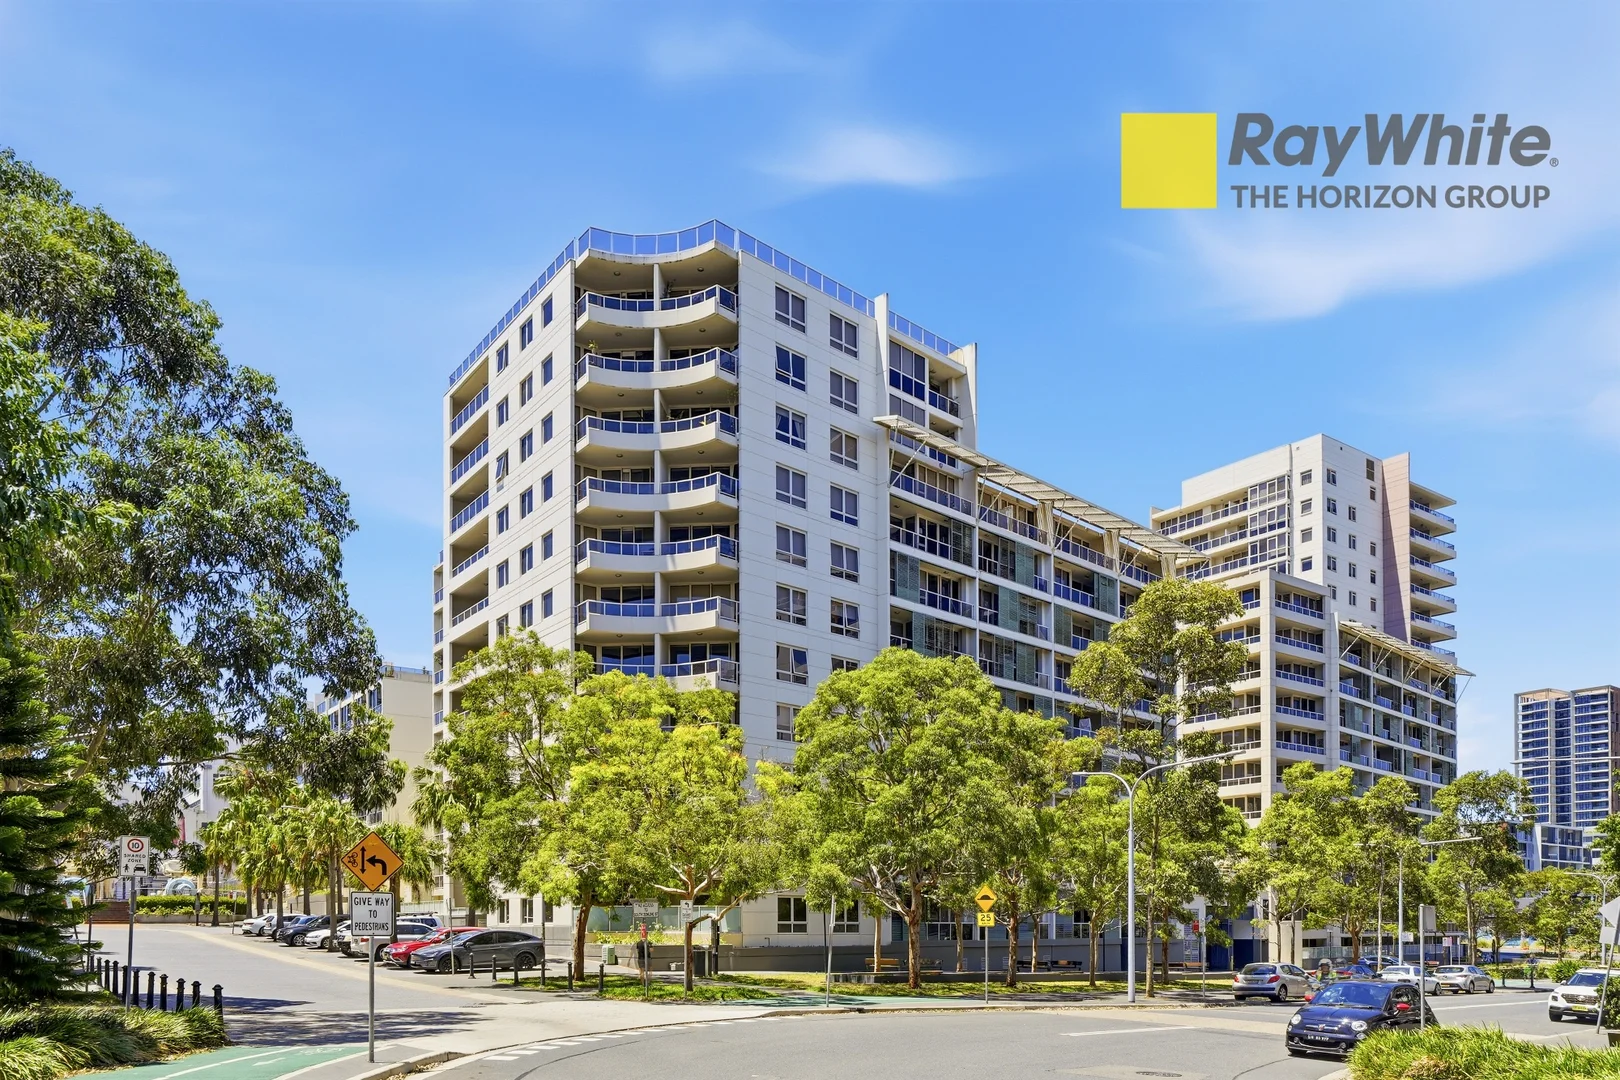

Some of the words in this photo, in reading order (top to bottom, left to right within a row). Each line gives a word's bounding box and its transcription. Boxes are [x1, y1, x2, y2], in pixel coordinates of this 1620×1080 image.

[353, 897, 372, 906] GIVE
[375, 897, 390, 907] WAY
[368, 909, 378, 918] TO
[980, 913, 991, 922] 25
